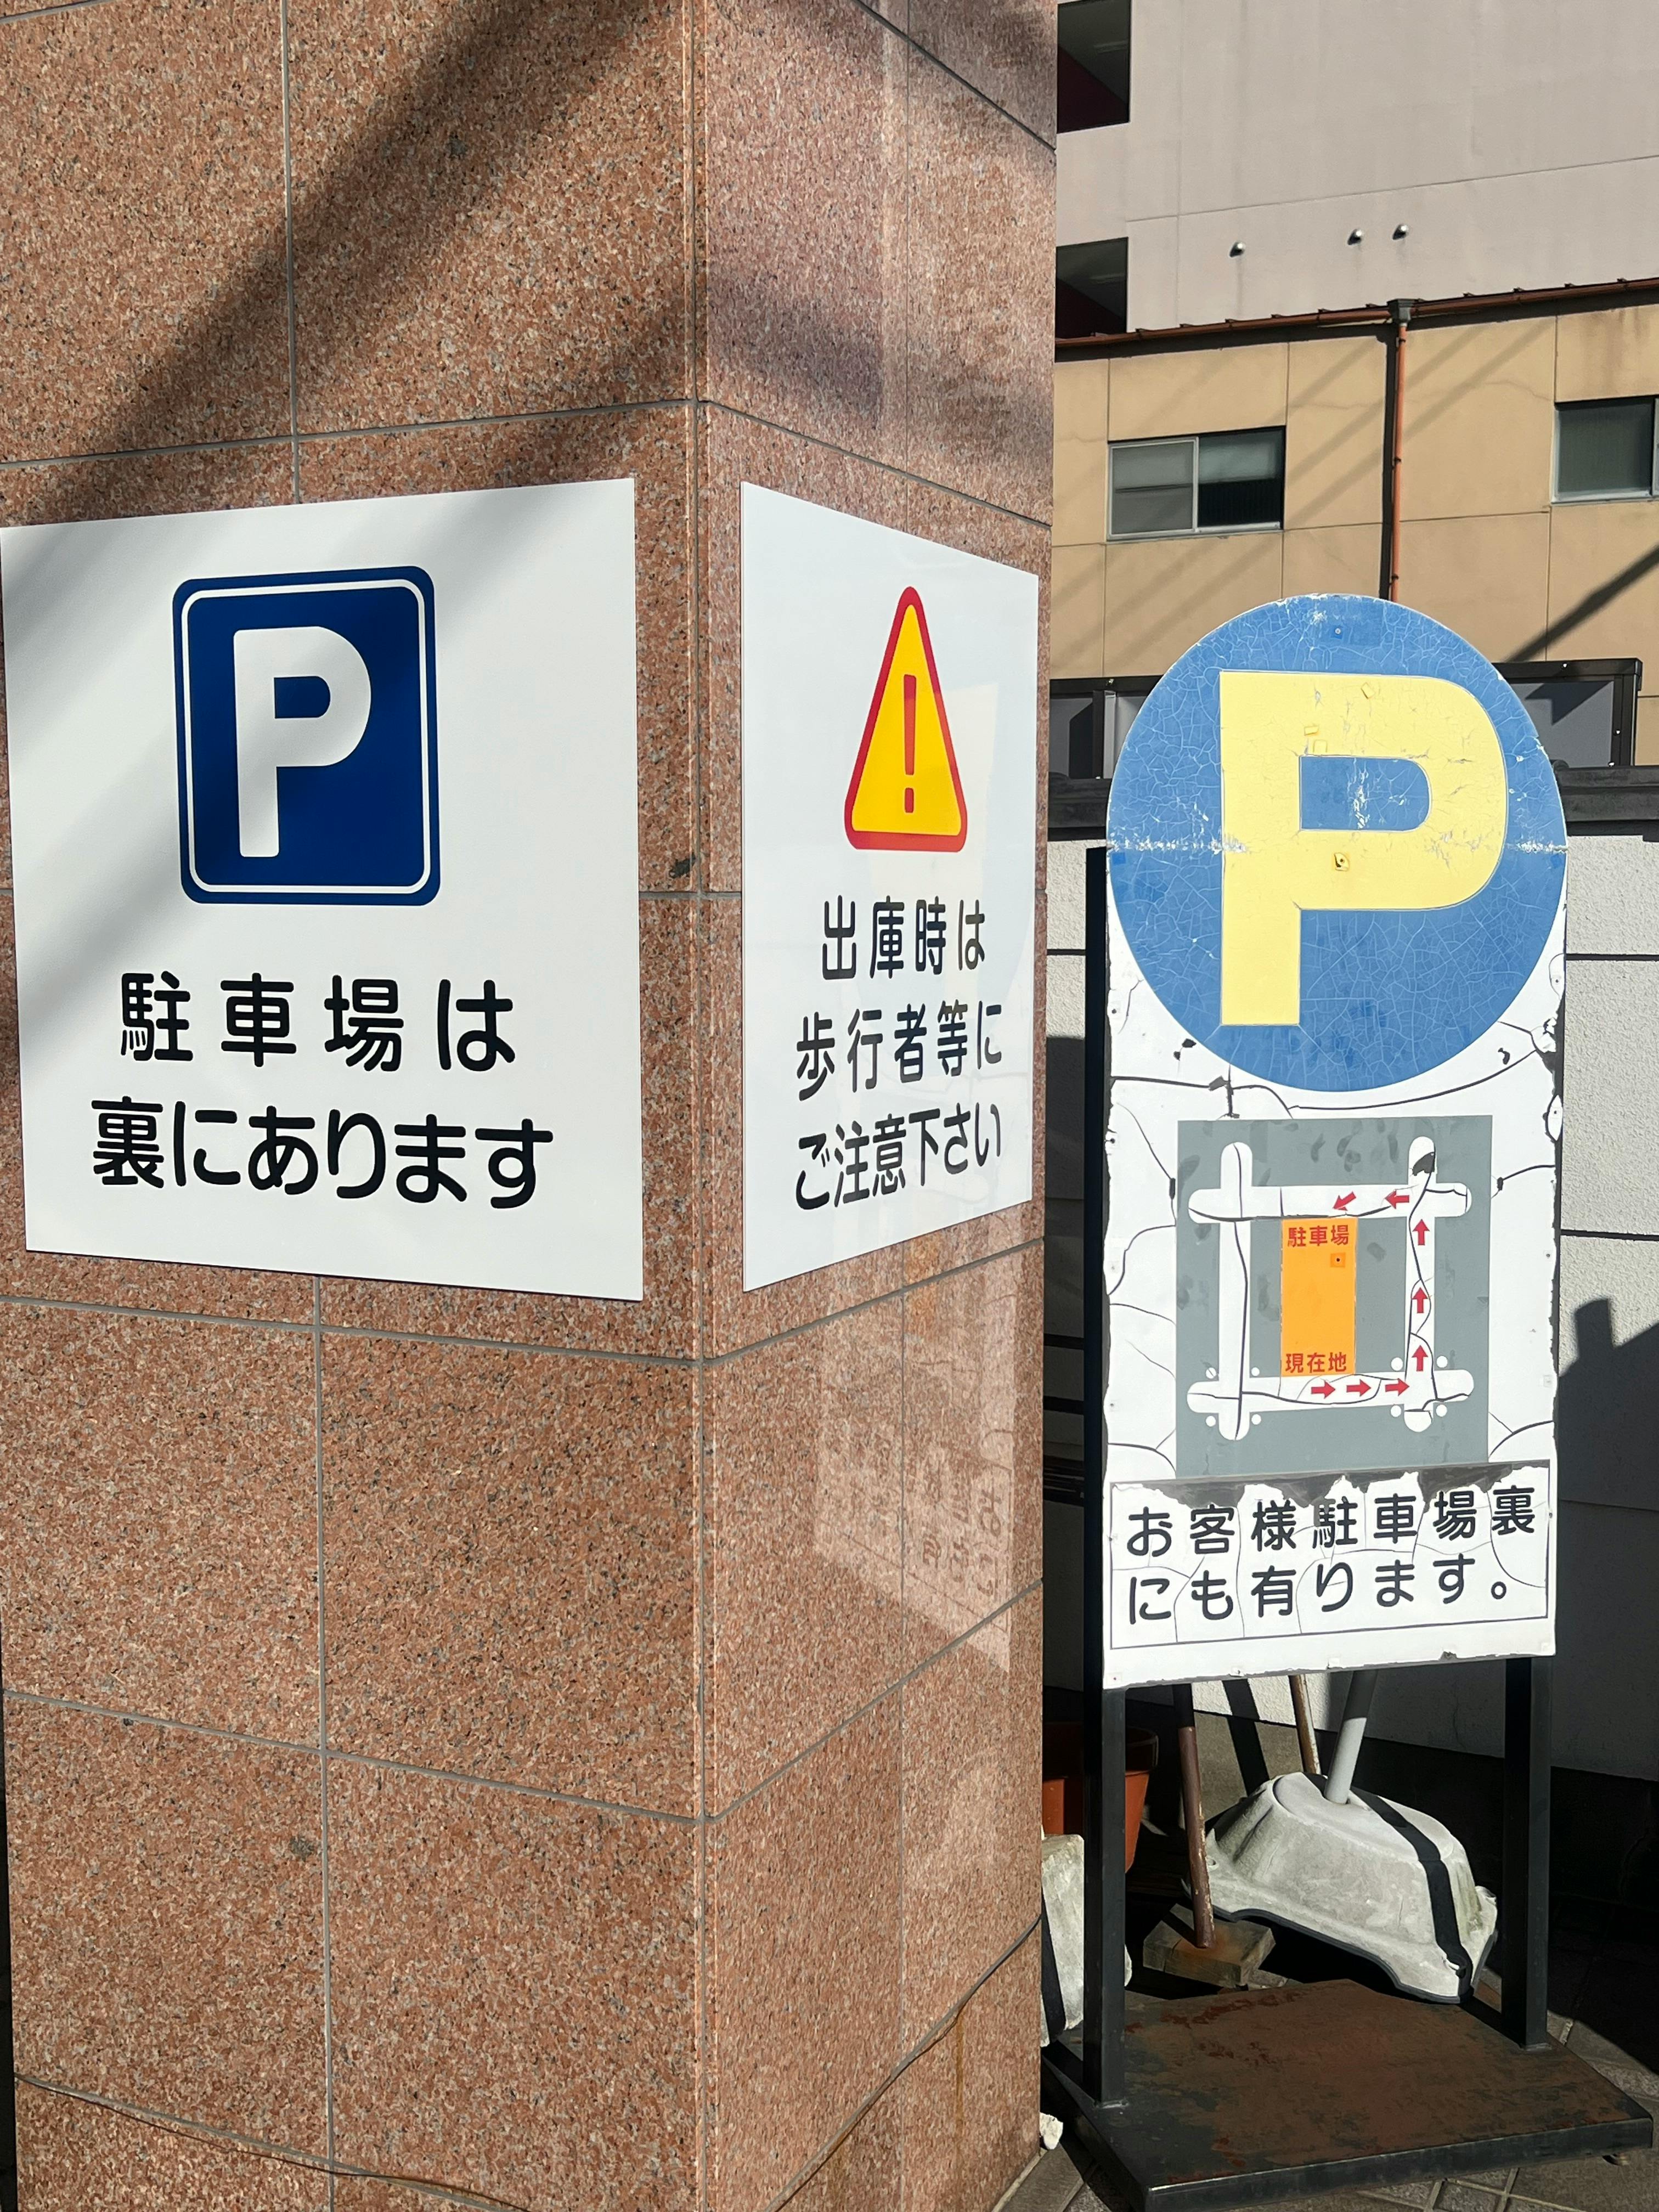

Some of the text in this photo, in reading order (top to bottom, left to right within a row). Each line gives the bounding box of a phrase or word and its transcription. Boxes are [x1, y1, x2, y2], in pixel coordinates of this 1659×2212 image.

[234, 625, 371, 857] P
[1220, 670, 1508, 1026] P
[821, 895, 986, 980] 出庫時は
[120, 971, 516, 1071] 駐車場は
[796, 1000, 1002, 1101] 歩行者等に
[91, 1096, 554, 1209] 裏にあります
[795, 1101, 1002, 1210] ご注意下さい
[1288, 1224, 1350, 1248] 駐車場
[1285, 1351, 1348, 1374] 現在地
[1127, 1485, 1536, 1558] お客様駐車場裏
[1129, 1553, 1508, 1625] にも有ります。
